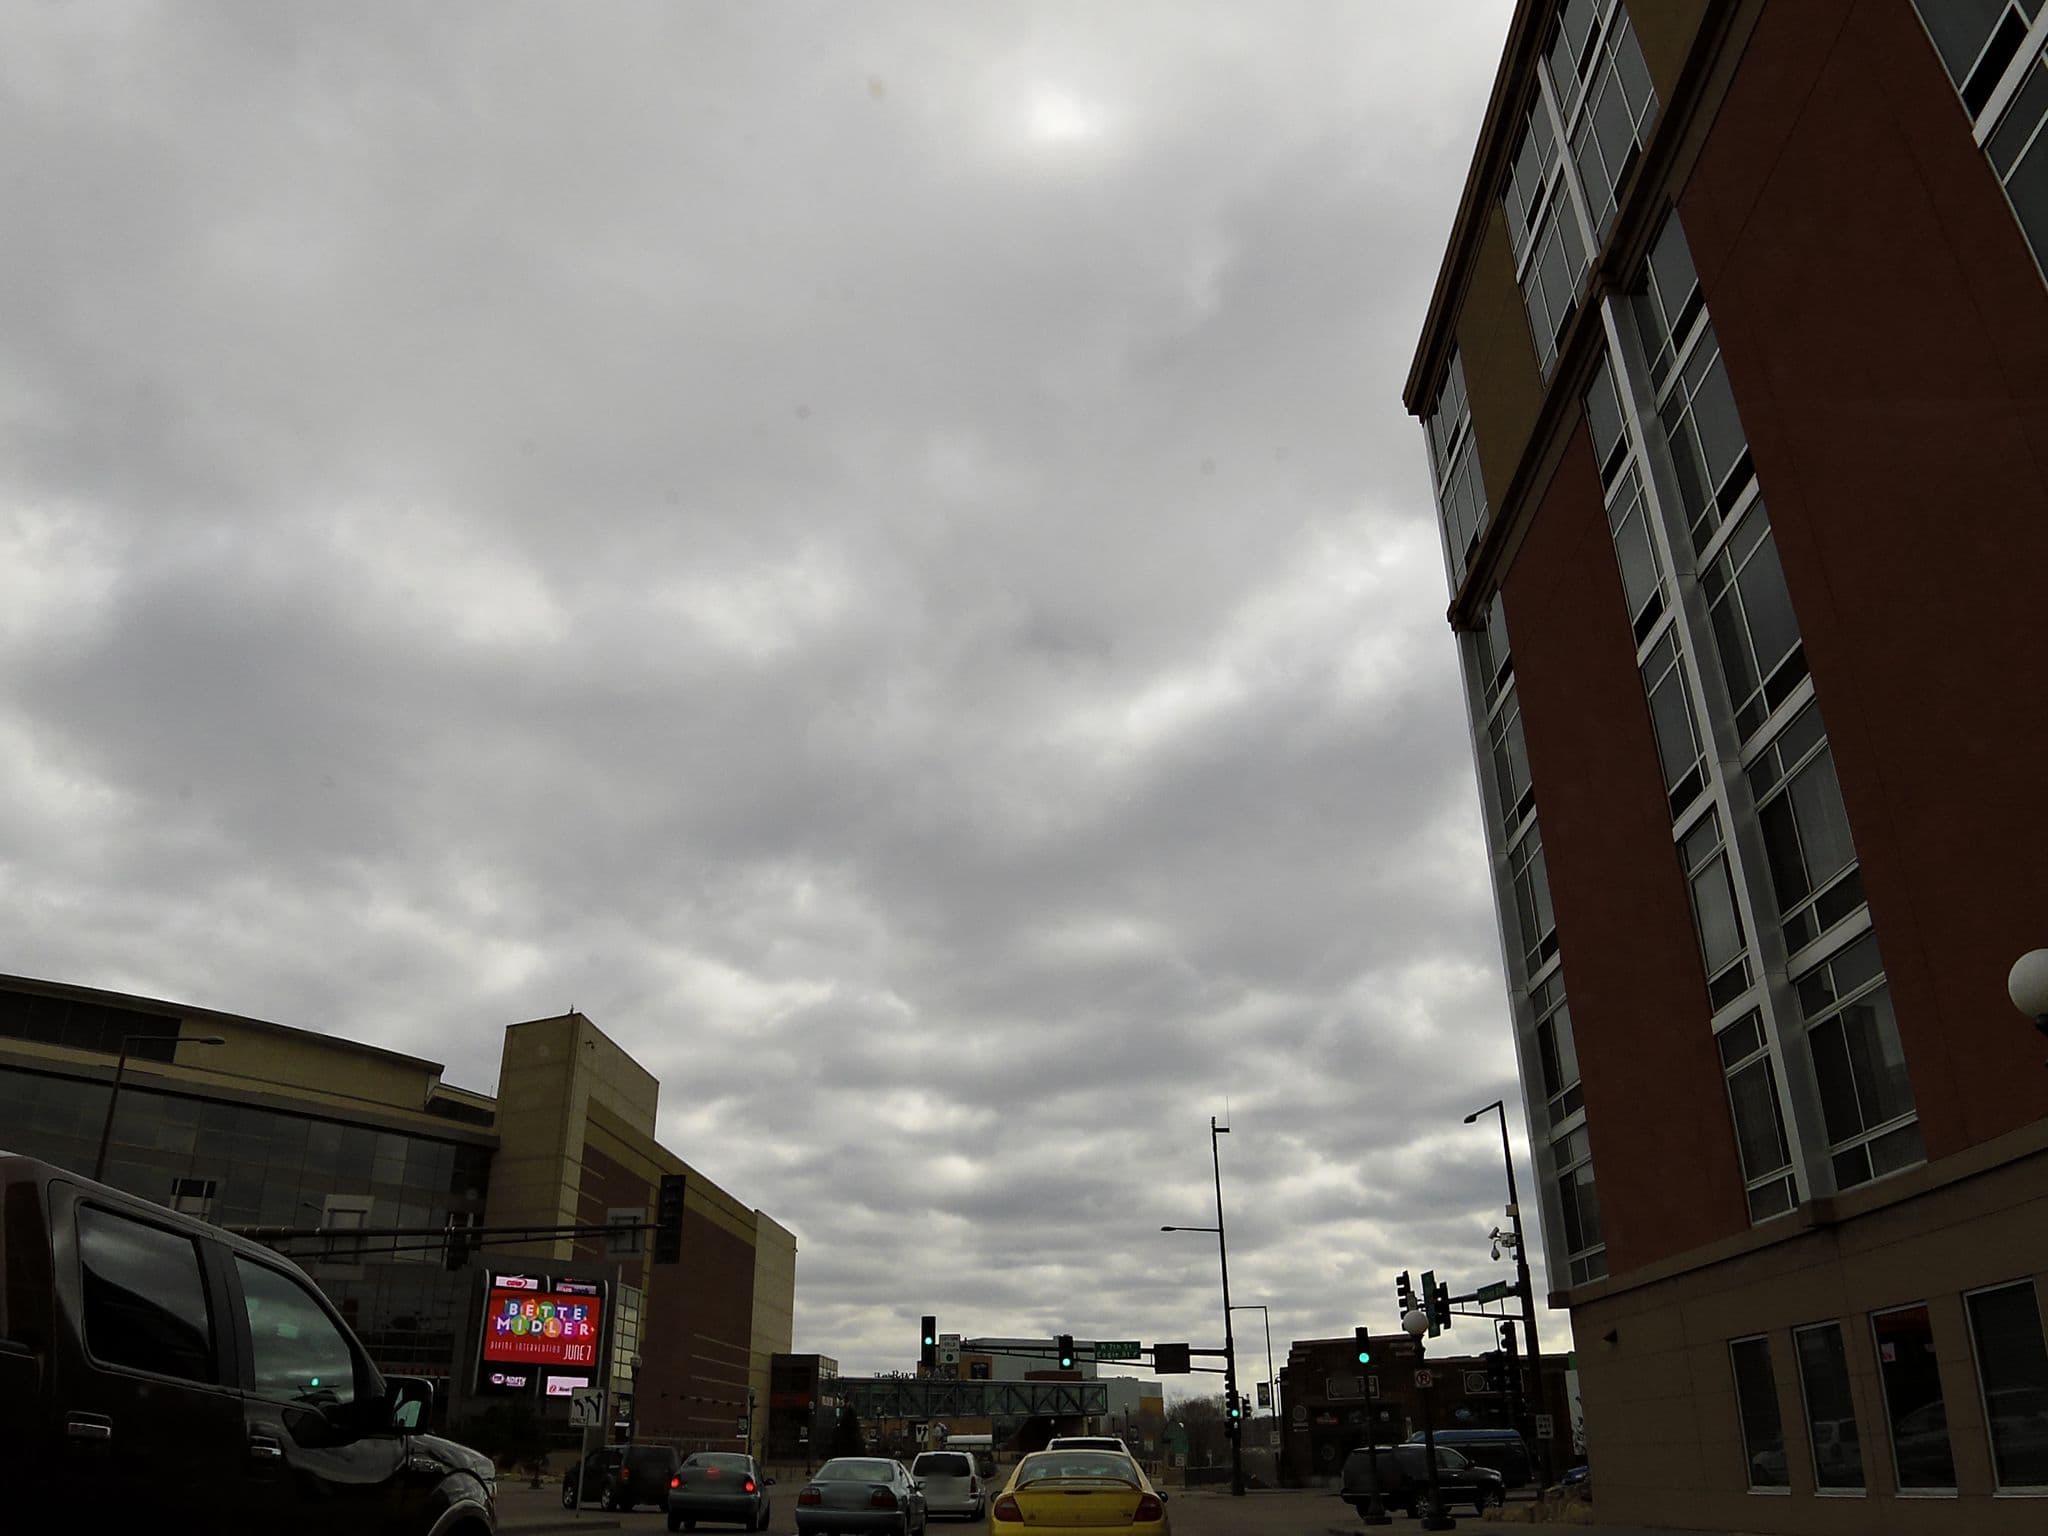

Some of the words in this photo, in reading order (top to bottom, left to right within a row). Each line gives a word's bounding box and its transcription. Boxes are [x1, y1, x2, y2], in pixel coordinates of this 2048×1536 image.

[508, 1303, 583, 1321] BETTE
[496, 1317, 590, 1336] MIDLER
[515, 1341, 562, 1354] INTERVENTION
[562, 1343, 585, 1361] JUNE
[585, 1345, 593, 1361] 7
